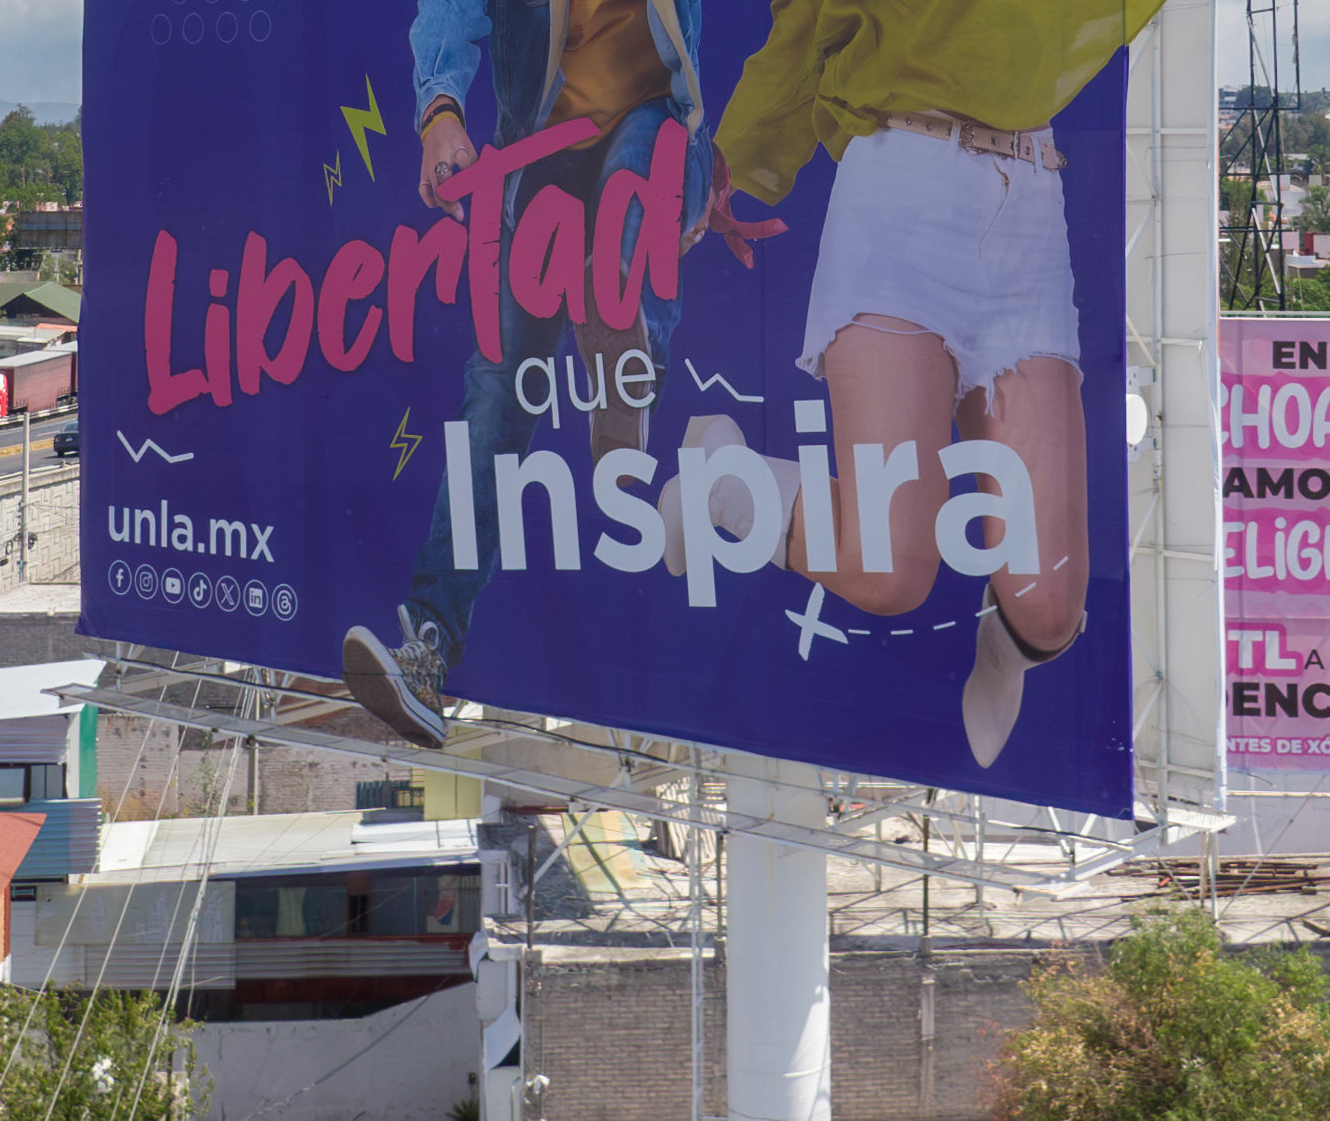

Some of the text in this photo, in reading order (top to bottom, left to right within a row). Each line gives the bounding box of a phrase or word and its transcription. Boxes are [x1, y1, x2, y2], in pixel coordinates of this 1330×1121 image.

[1272, 341, 1327, 370] EN
[514, 347, 657, 428] que
[444, 399, 1041, 608] Inspira
[108, 499, 275, 563] unla.mx
[1227, 630, 1296, 670] TL
[1304, 649, 1325, 670] A
[1276, 739, 1302, 754] DE
